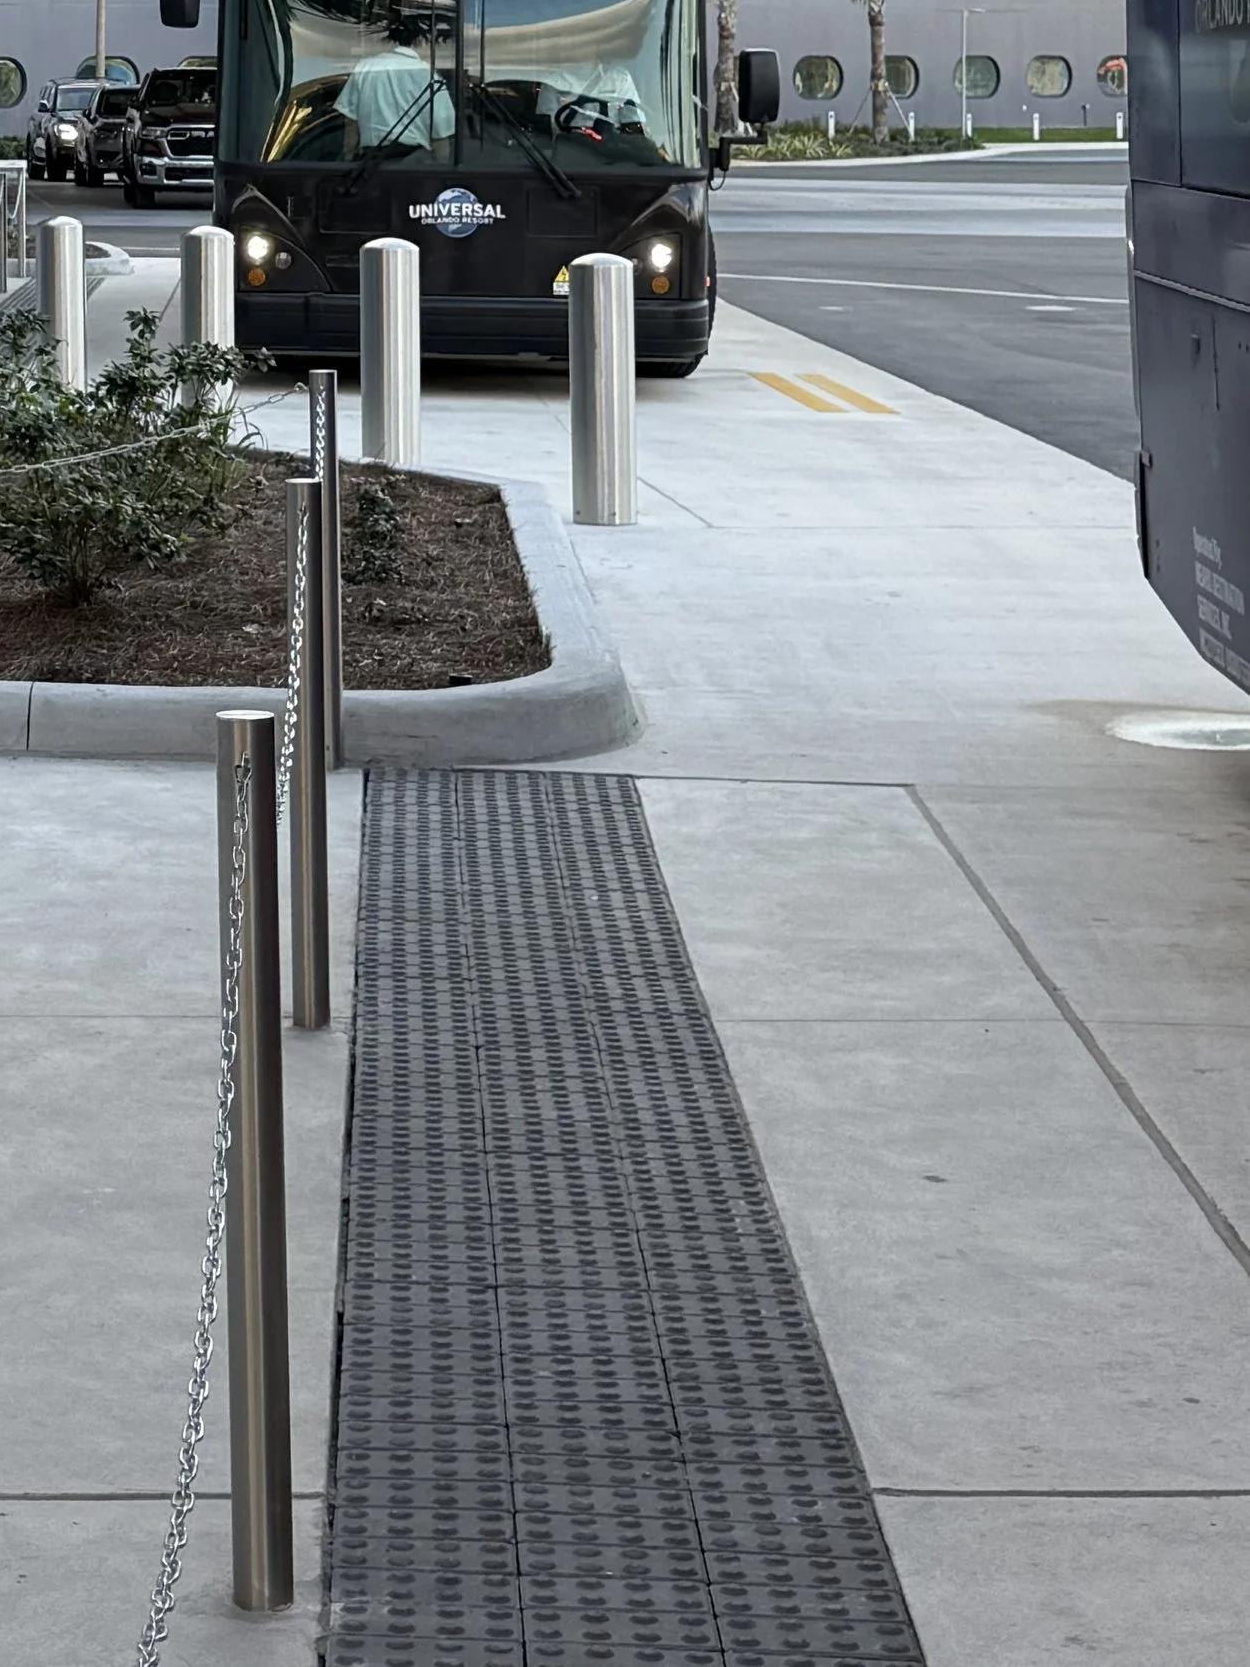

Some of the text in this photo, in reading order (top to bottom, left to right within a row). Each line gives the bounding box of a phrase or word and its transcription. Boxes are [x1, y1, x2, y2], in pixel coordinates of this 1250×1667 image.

[408, 202, 506, 219] UNIVERSAL
[421, 217, 494, 225] ORLANDO RESORT
